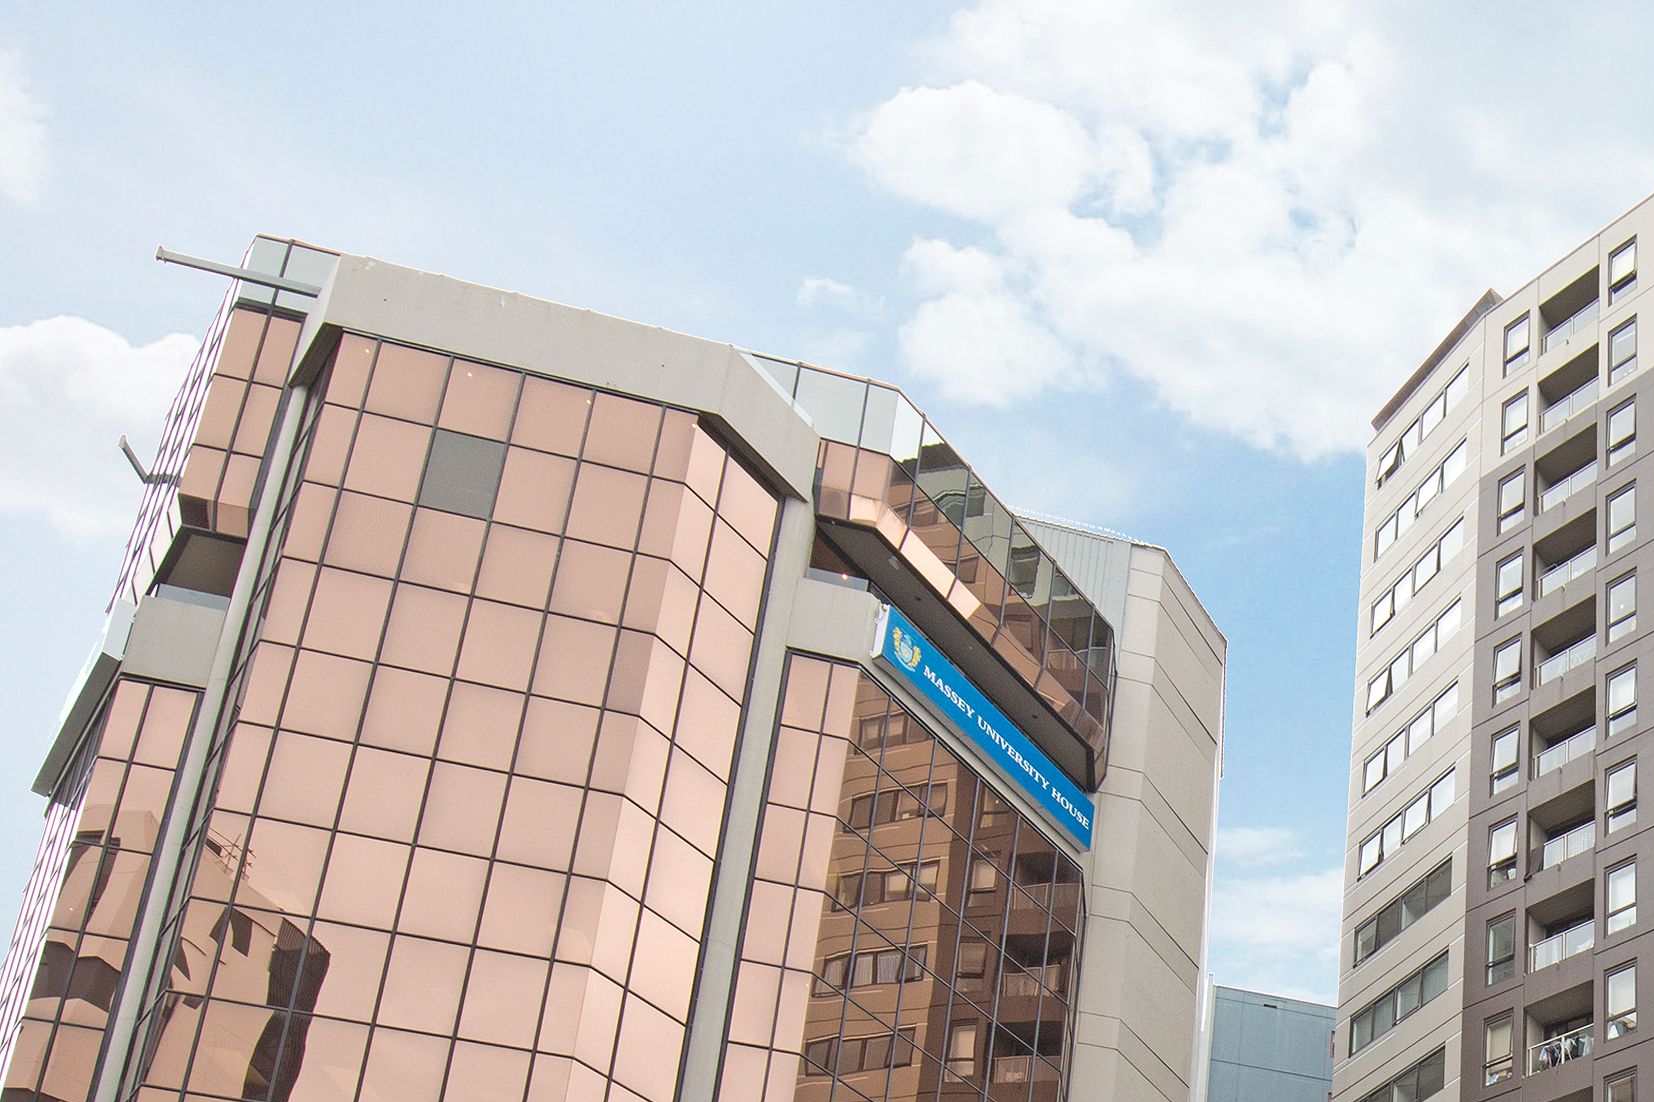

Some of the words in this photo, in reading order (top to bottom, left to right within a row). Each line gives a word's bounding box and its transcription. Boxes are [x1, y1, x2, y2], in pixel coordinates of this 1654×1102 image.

[923, 665, 975, 719] MASSEY
[977, 715, 1050, 790] UNIVERSITY
[1051, 786, 1090, 830] HOUSE
